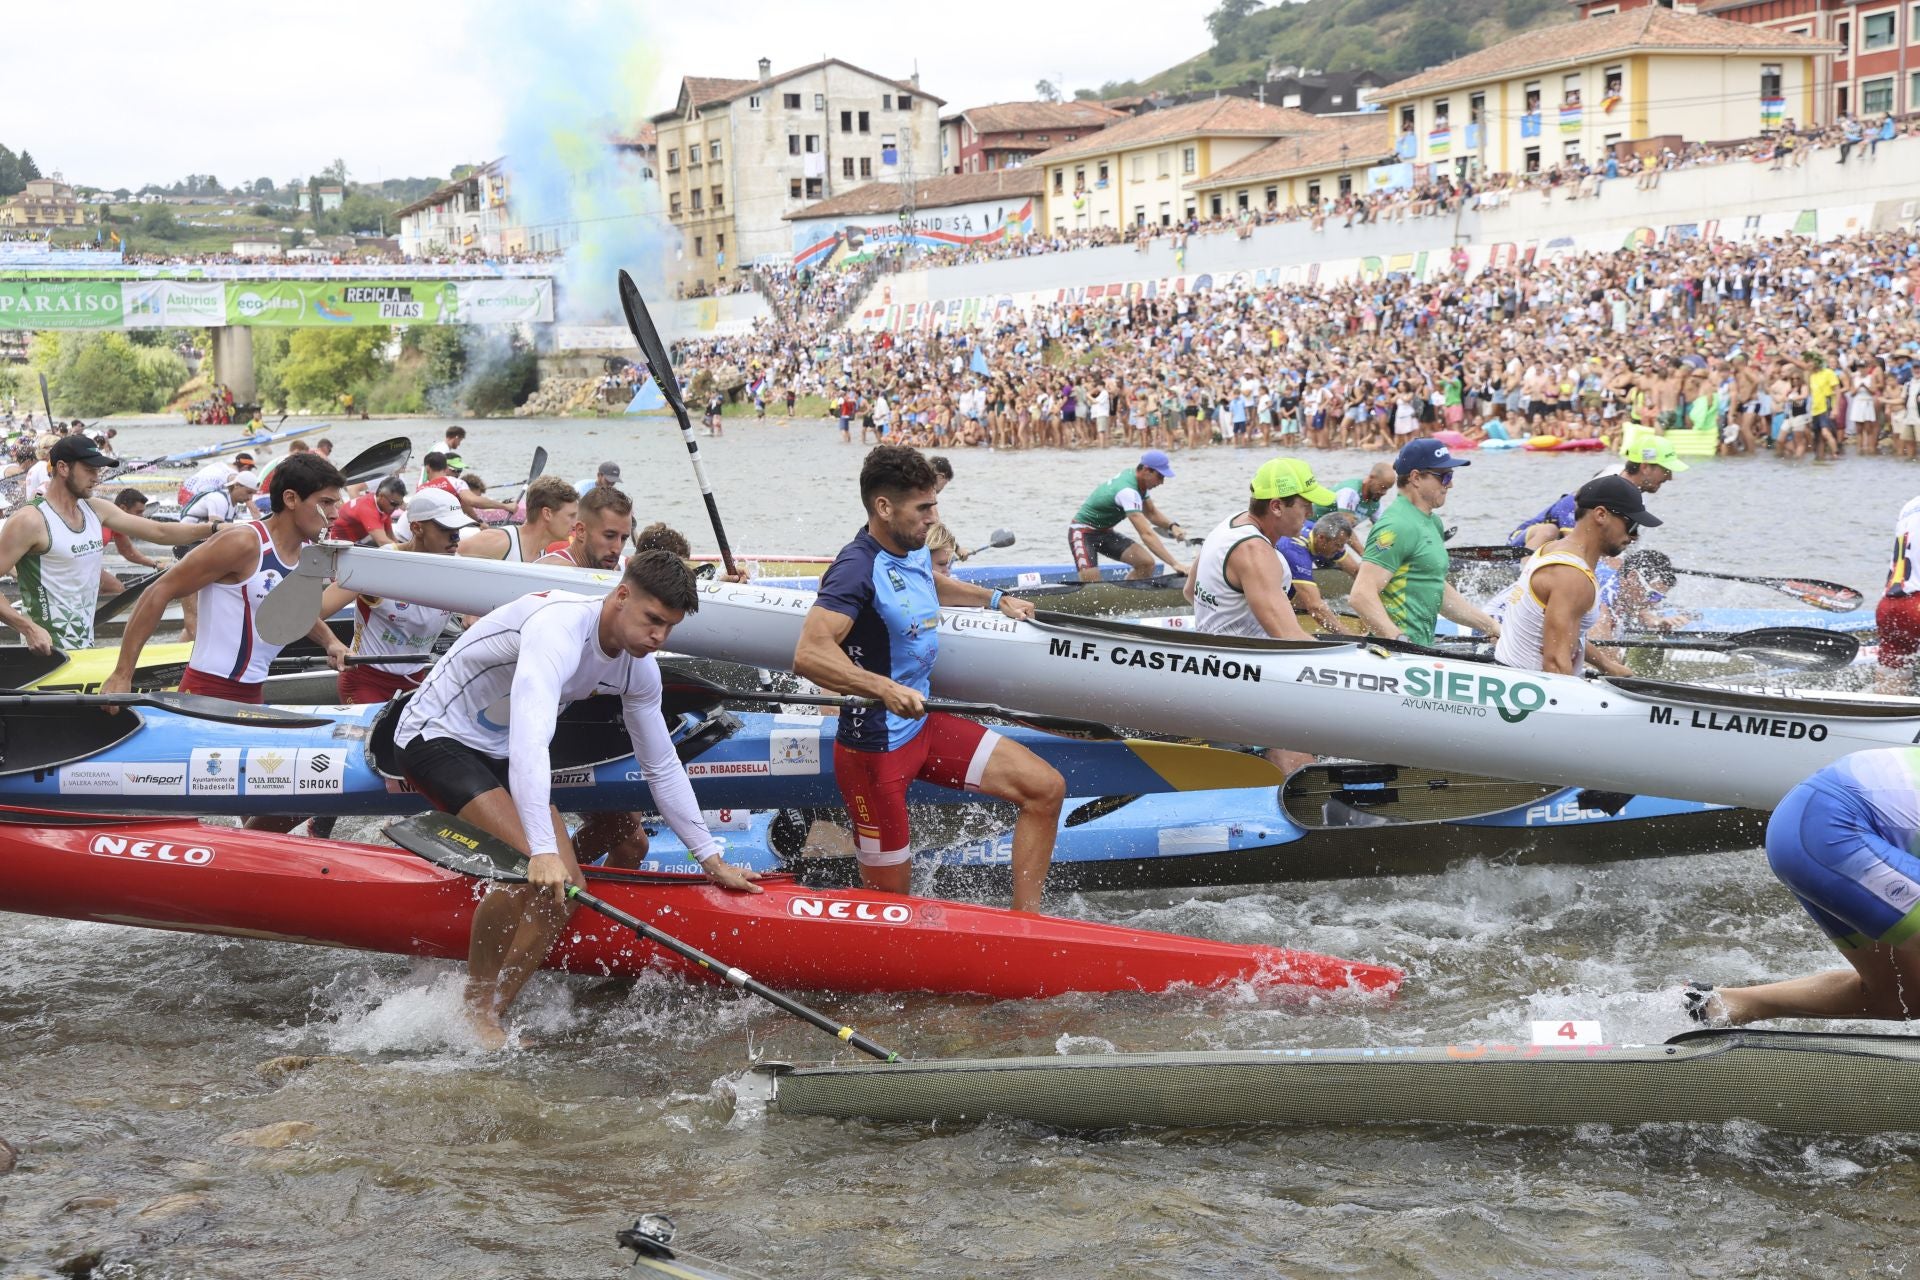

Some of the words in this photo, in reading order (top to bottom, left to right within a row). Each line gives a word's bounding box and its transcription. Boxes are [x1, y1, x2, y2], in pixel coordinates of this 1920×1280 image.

[1, 292, 117, 313] PARAÍSO
[166, 293, 218, 306] Asturias
[346, 287, 400, 303] RECICLA
[382, 303, 420, 317] PILAS
[1167, 618, 1183, 628] 16
[1049, 637, 1100, 662] M.F.
[1110, 646, 1262, 683] CASTAÑON
[1295, 665, 1400, 695] ASTOR
[1401, 698, 1487, 718] AYUNTAMIENTO
[1649, 705, 1680, 726] M.
[1690, 710, 1829, 743] LLAMEDO
[688, 765, 709, 776] SCD.
[710, 763, 769, 775] RIBADESELLA
[135, 774, 184, 786] infisport
[192, 776, 228, 784] Ayuntamiento
[267, 776, 292, 784] RURAL
[299, 779, 339, 789] SIROKO
[719, 808, 732, 823] 8
[855, 795, 870, 823] ESP
[94, 836, 211, 865] NELO
[792, 899, 909, 922] NELO
[1557, 1021, 1578, 1040] 4
